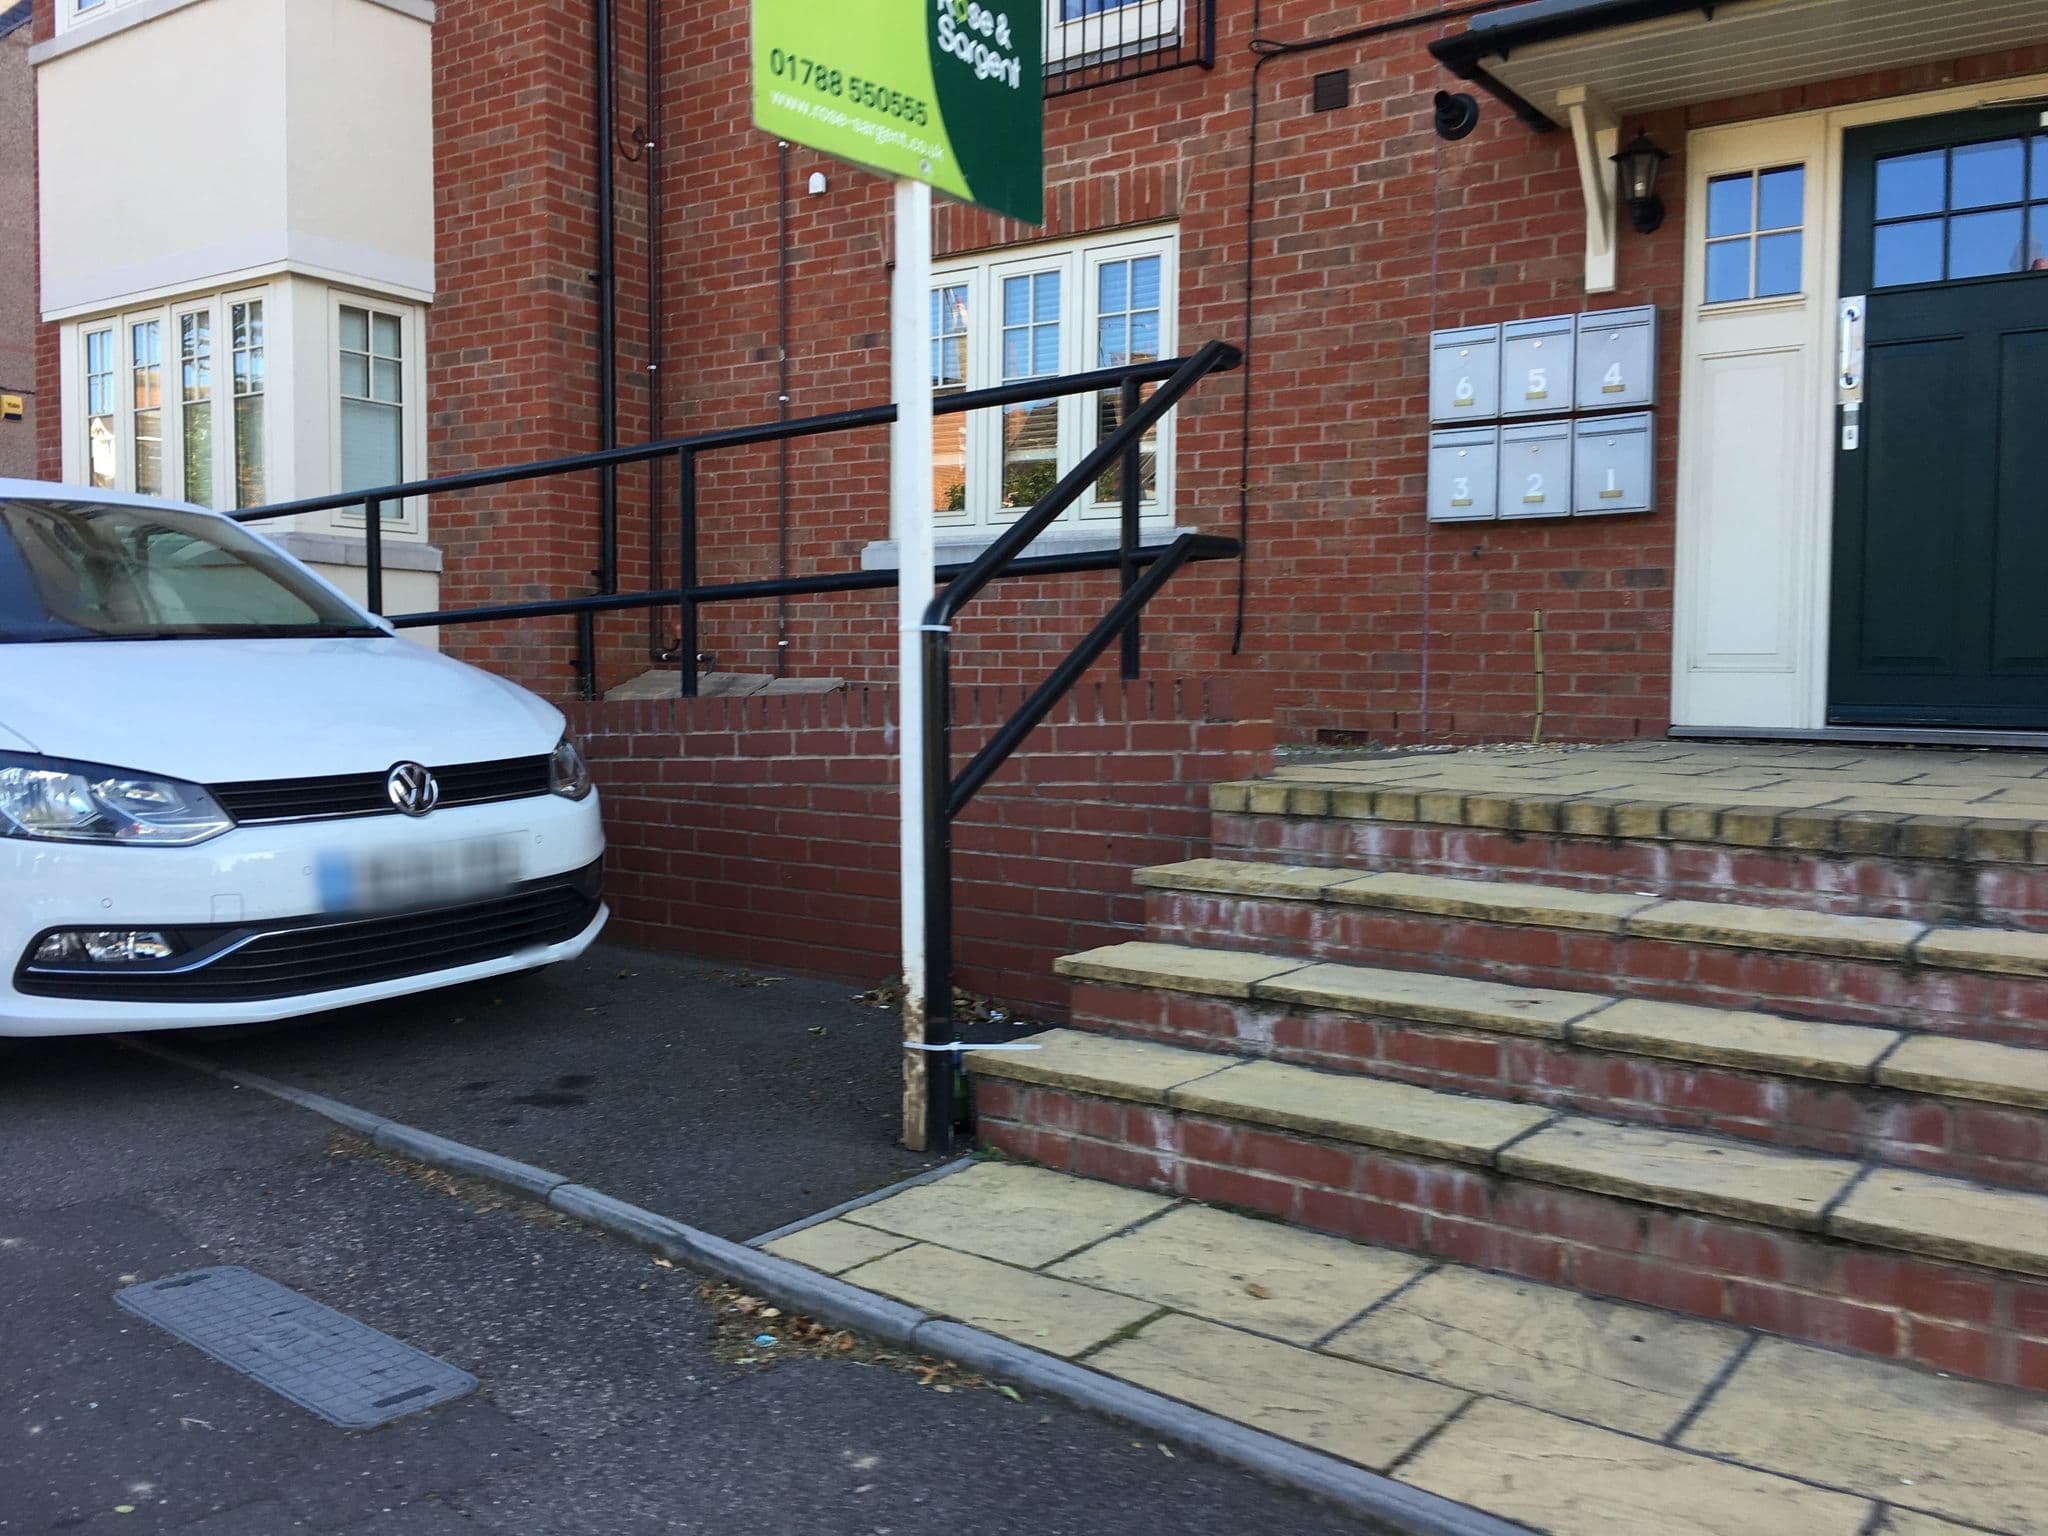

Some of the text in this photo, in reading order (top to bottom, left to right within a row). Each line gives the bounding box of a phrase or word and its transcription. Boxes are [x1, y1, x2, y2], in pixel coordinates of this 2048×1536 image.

[995, 13, 1013, 51] &
[937, 14, 1021, 89] Sargent
[770, 48, 928, 126] 01788 550555
[1528, 368, 1547, 393] 5
[1603, 362, 1622, 385] 4
[1455, 376, 1474, 399] 6
[1453, 477, 1469, 499] 3
[1526, 473, 1544, 497] 2
[1605, 468, 1616, 490] 1
